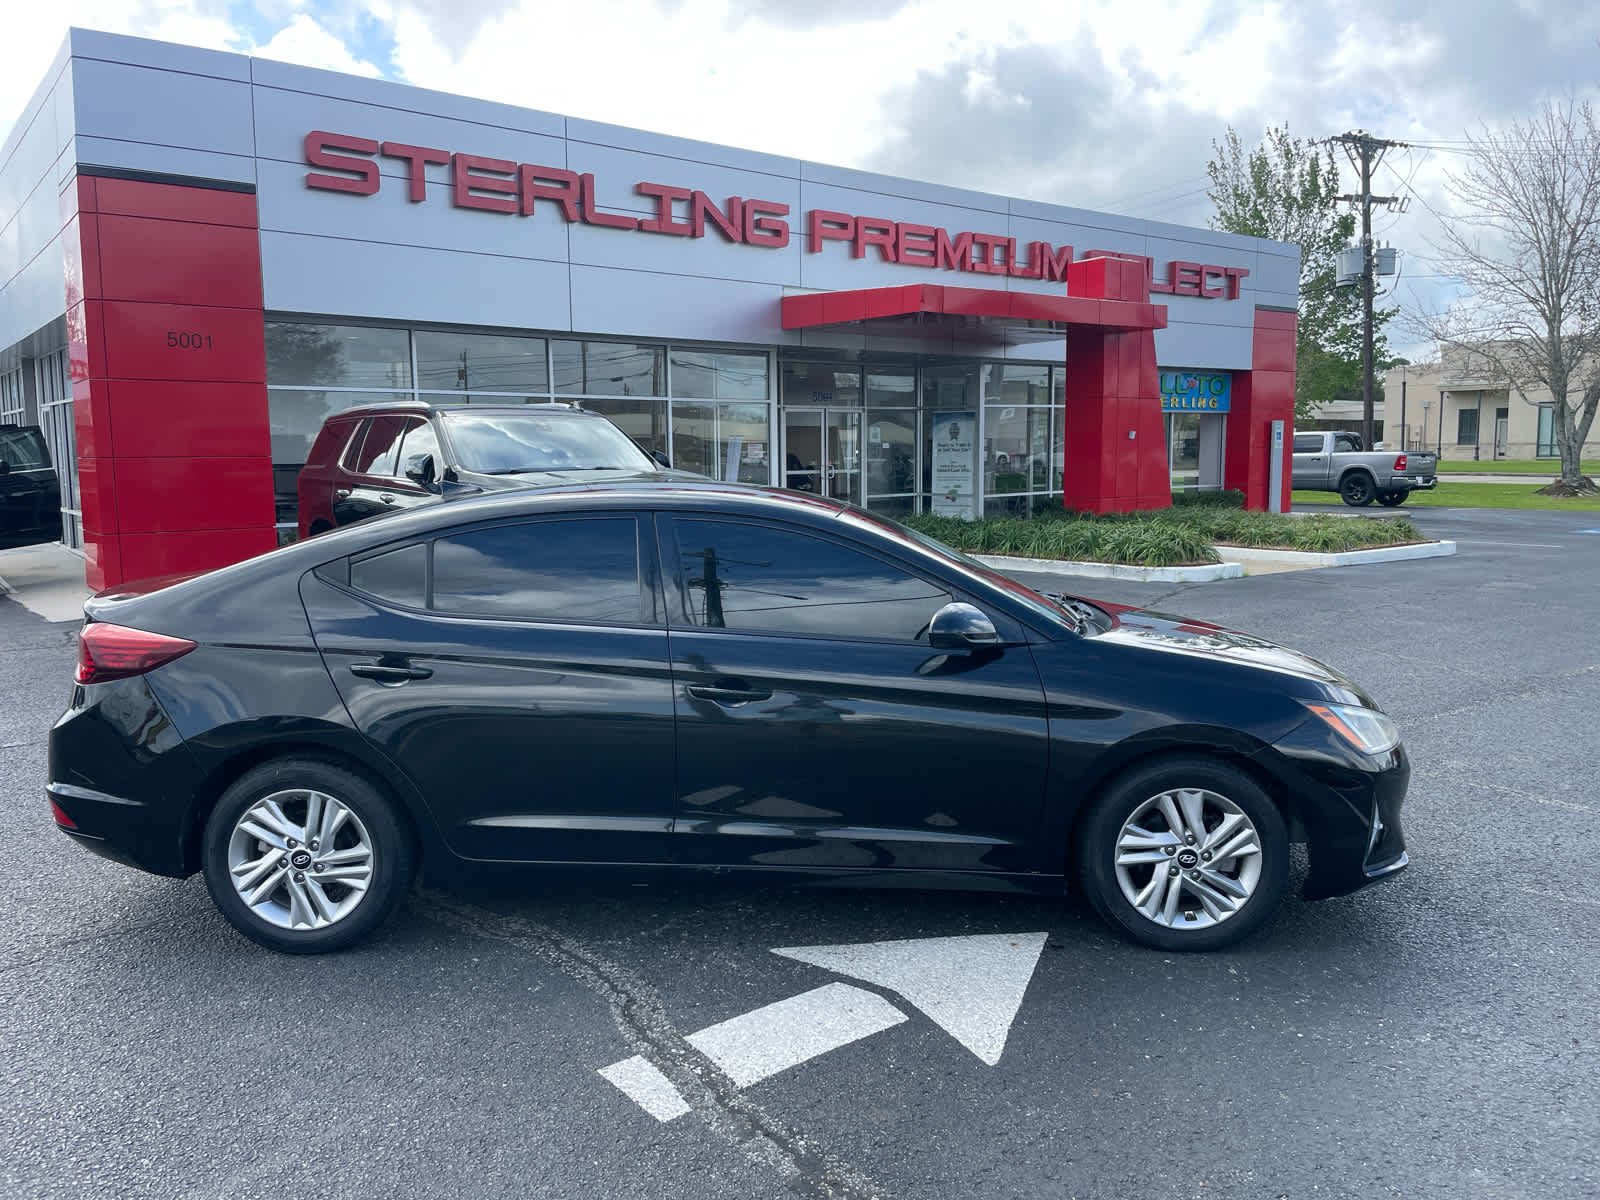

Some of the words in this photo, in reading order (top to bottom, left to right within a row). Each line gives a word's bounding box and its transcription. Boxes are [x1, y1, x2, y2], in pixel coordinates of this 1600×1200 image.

[305, 130, 789, 248] STERLING
[808, 209, 1073, 282] PREMIUM
[1084, 248, 1250, 300] LECT
[167, 331, 212, 349] 5001
[1195, 374, 1226, 396] TO
